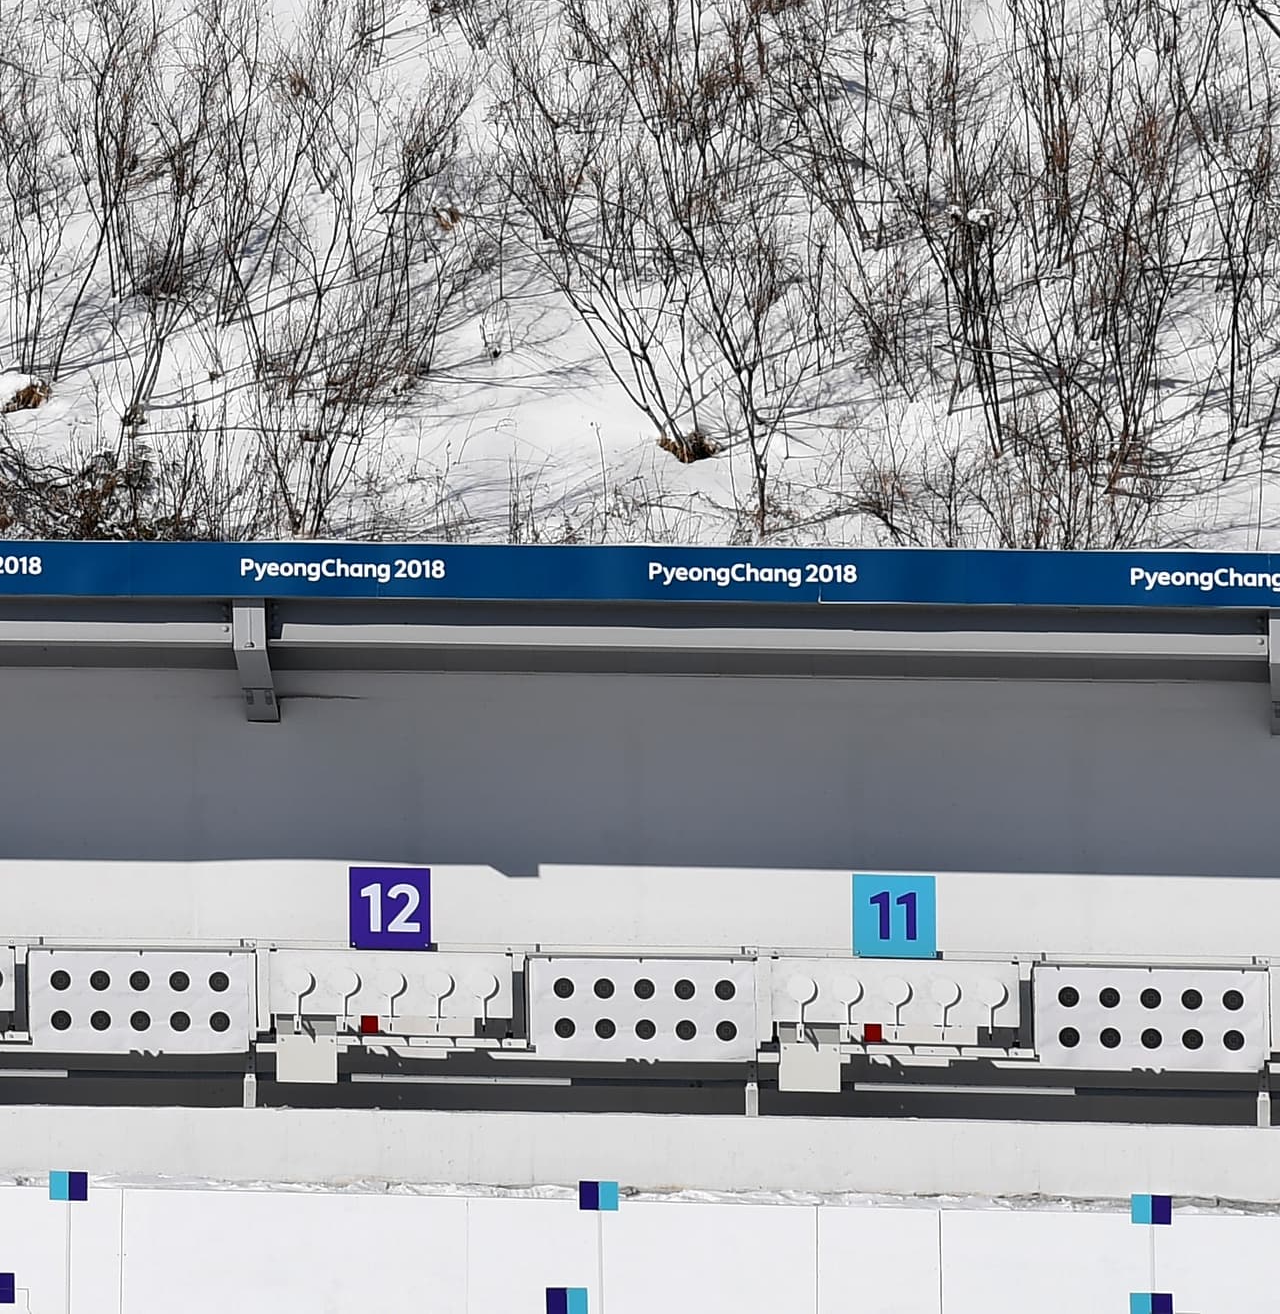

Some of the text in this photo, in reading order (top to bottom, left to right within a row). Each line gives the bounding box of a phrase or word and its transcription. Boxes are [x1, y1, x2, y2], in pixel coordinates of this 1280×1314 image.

[241, 559, 445, 582] PyeongChang 2018
[649, 563, 857, 587] PyeongChang 2018
[360, 883, 421, 933] 12
[869, 892, 917, 941] 11
